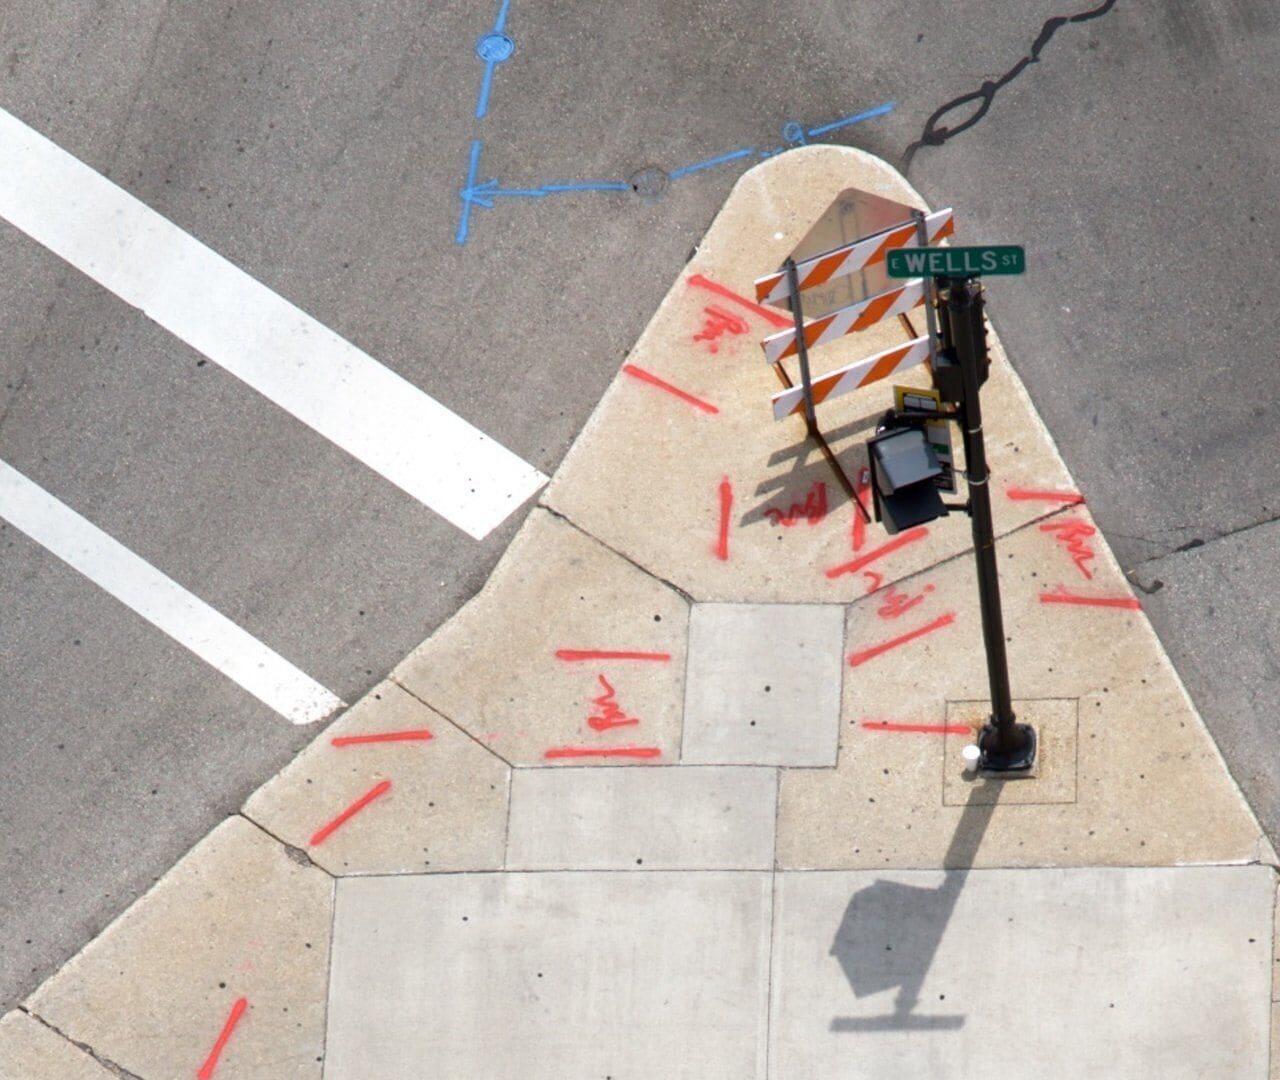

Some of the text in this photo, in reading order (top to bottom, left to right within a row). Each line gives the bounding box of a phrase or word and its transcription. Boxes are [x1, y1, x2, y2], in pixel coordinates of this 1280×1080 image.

[891, 250, 1018, 273] E WELLS ST
